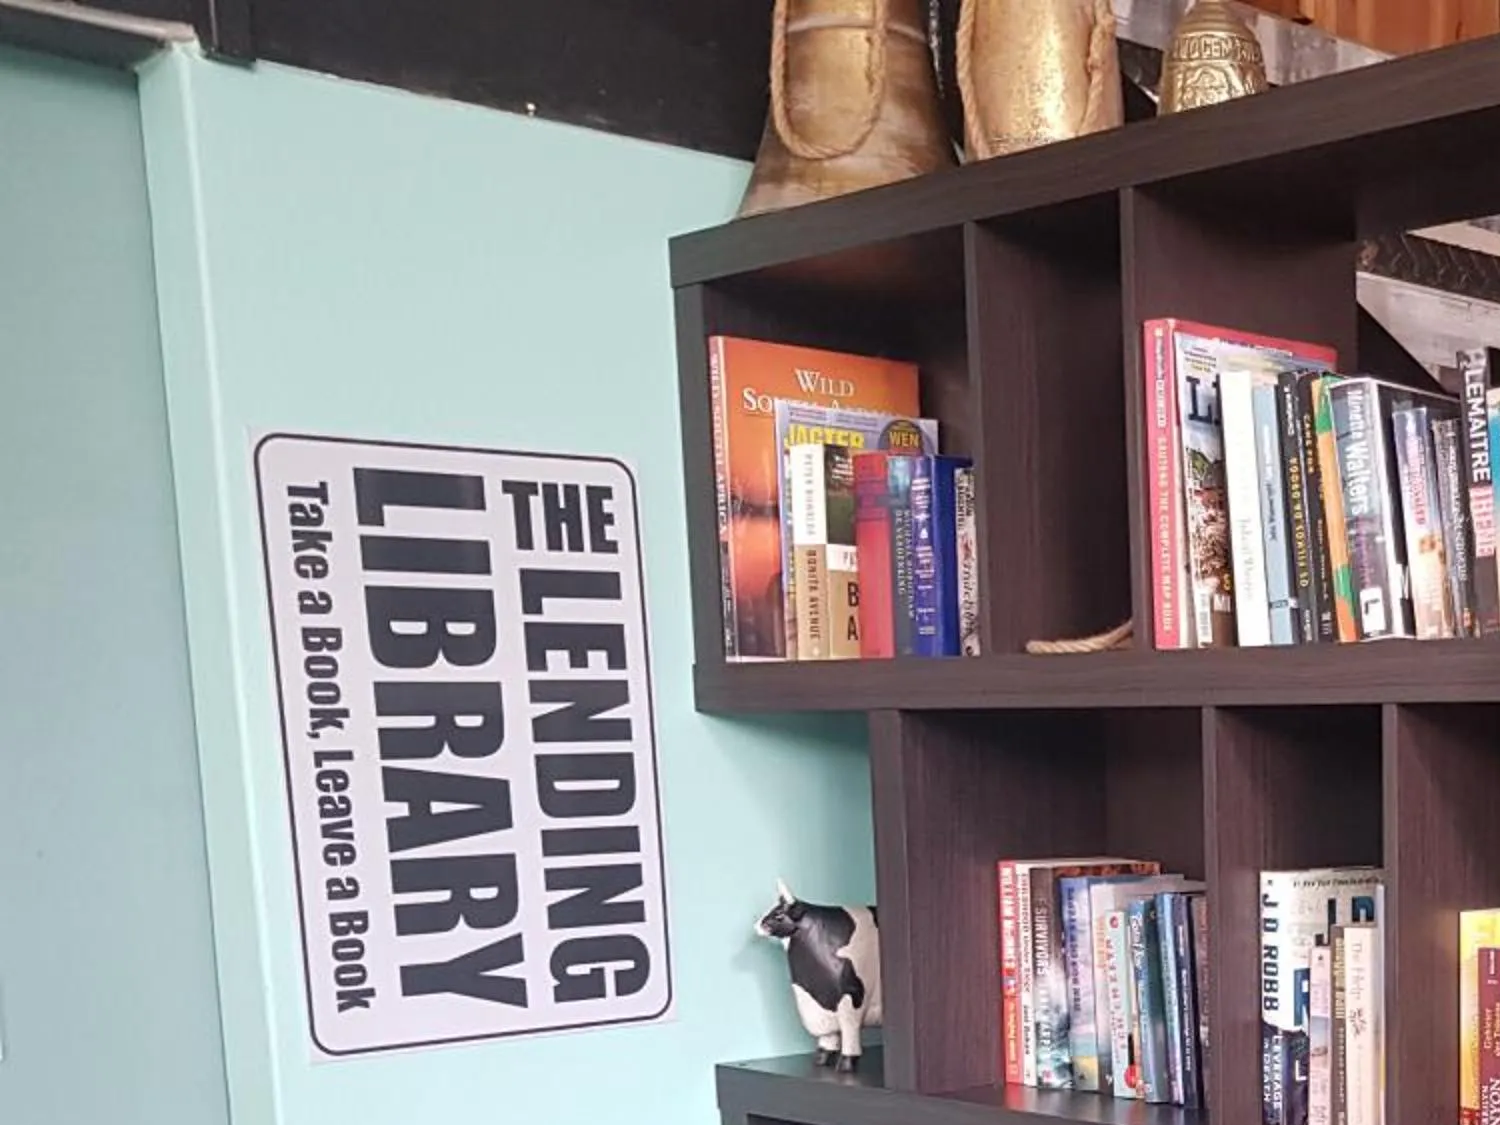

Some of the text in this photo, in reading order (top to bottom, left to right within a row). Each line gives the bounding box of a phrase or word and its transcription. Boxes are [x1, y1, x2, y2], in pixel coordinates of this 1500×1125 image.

[1464, 368, 1492, 482] LEMAITRE
[501, 480, 619, 555] THE
[716, 470, 728, 536] AFRICA
[1345, 440, 1371, 516] Walters
[286, 481, 377, 1014] Take a Book, Leave a Book
[352, 466, 529, 1009] LIBRARY
[519, 568, 652, 1005] LENDING
[1035, 907, 1049, 976] SURVIVORS
[1263, 893, 1279, 1012] J D ROBB
[1271, 1034, 1283, 1111] LEVERAGE
